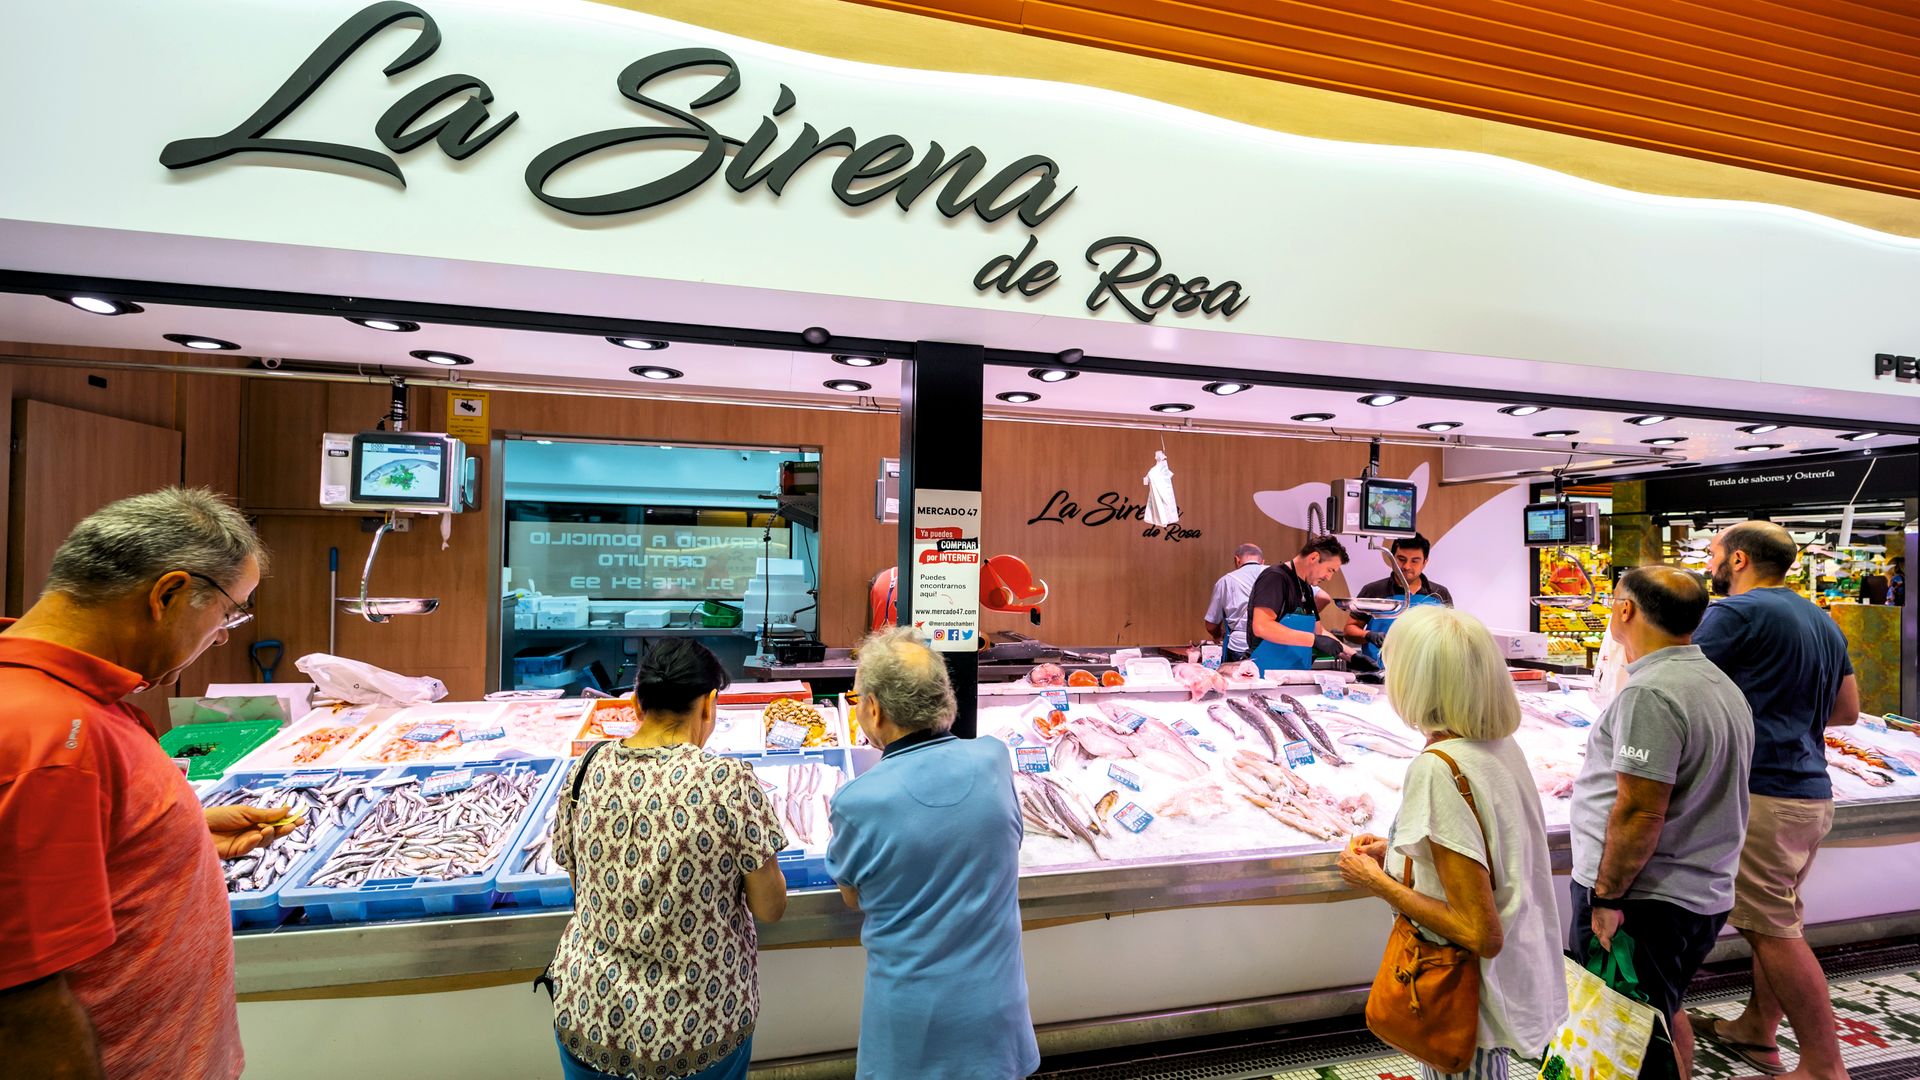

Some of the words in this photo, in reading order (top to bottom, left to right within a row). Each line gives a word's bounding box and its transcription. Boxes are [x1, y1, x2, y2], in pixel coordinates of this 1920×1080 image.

[159, 0, 519, 190] La
[525, 47, 1077, 228] Sirena
[973, 234, 1061, 296] de
[1085, 236, 1250, 322] Rosa
[1707, 478, 1736, 486] Tienda
[1750, 475, 1785, 483] sabores
[1786, 475, 1793, 483] y
[1794, 469, 1835, 480] Ostrería
[917, 506, 966, 516] MERCADO
[967, 508, 978, 517] 47
[1027, 490, 1081, 525] La
[1082, 492, 1184, 526] Sire
[930, 531, 953, 539] puedes
[1142, 525, 1160, 538] de
[1164, 523, 1202, 543] Rosa
[941, 540, 977, 550] COMPRAR
[926, 555, 938, 563] por
[939, 553, 977, 562] INTERNET
